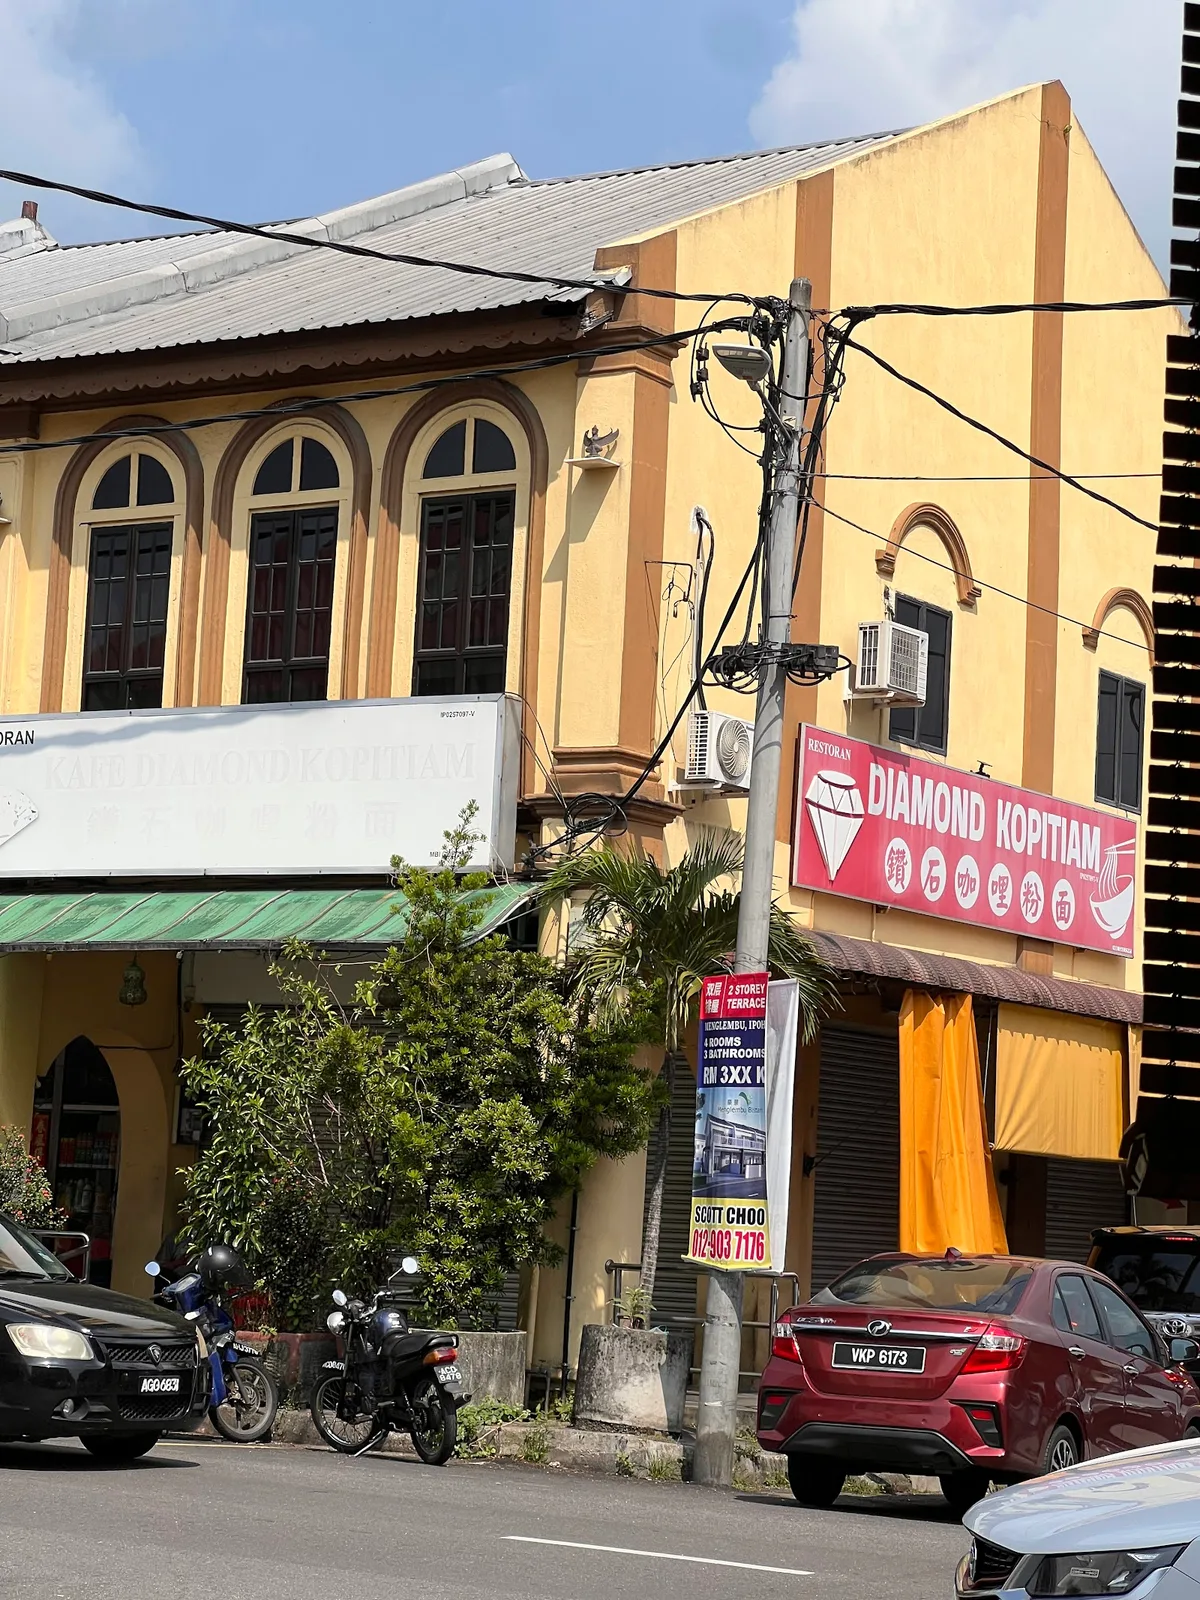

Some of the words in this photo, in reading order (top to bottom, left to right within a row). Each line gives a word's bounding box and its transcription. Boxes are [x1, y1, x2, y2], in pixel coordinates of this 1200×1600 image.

[808, 737, 852, 761] RESTORAN
[132, 748, 293, 790] DIAMOND
[299, 742, 477, 786] KOPITIAM
[867, 762, 986, 842] DIAMOND
[996, 798, 1101, 874] KOPITIAM
[886, 846, 1071, 925] 鑽石咖哩粉面
[728, 985, 734, 995] 2
[735, 983, 766, 995] STOREY
[727, 997, 766, 1009] TERRACE
[703, 1037, 708, 1048] 4
[709, 1036, 742, 1048] ROOMS
[703, 1050, 708, 1059] 3
[709, 1048, 766, 1059] BATHROOMS
[703, 1066, 718, 1084] RM
[720, 1066, 752, 1084] 3XX
[695, 1205, 724, 1224] SCOTT
[726, 1207, 765, 1226] CHOO
[692, 1228, 732, 1260] 012-903
[735, 1231, 765, 1261] 7176
[851, 1347, 876, 1364] VKP
[878, 1349, 908, 1366] 6173
